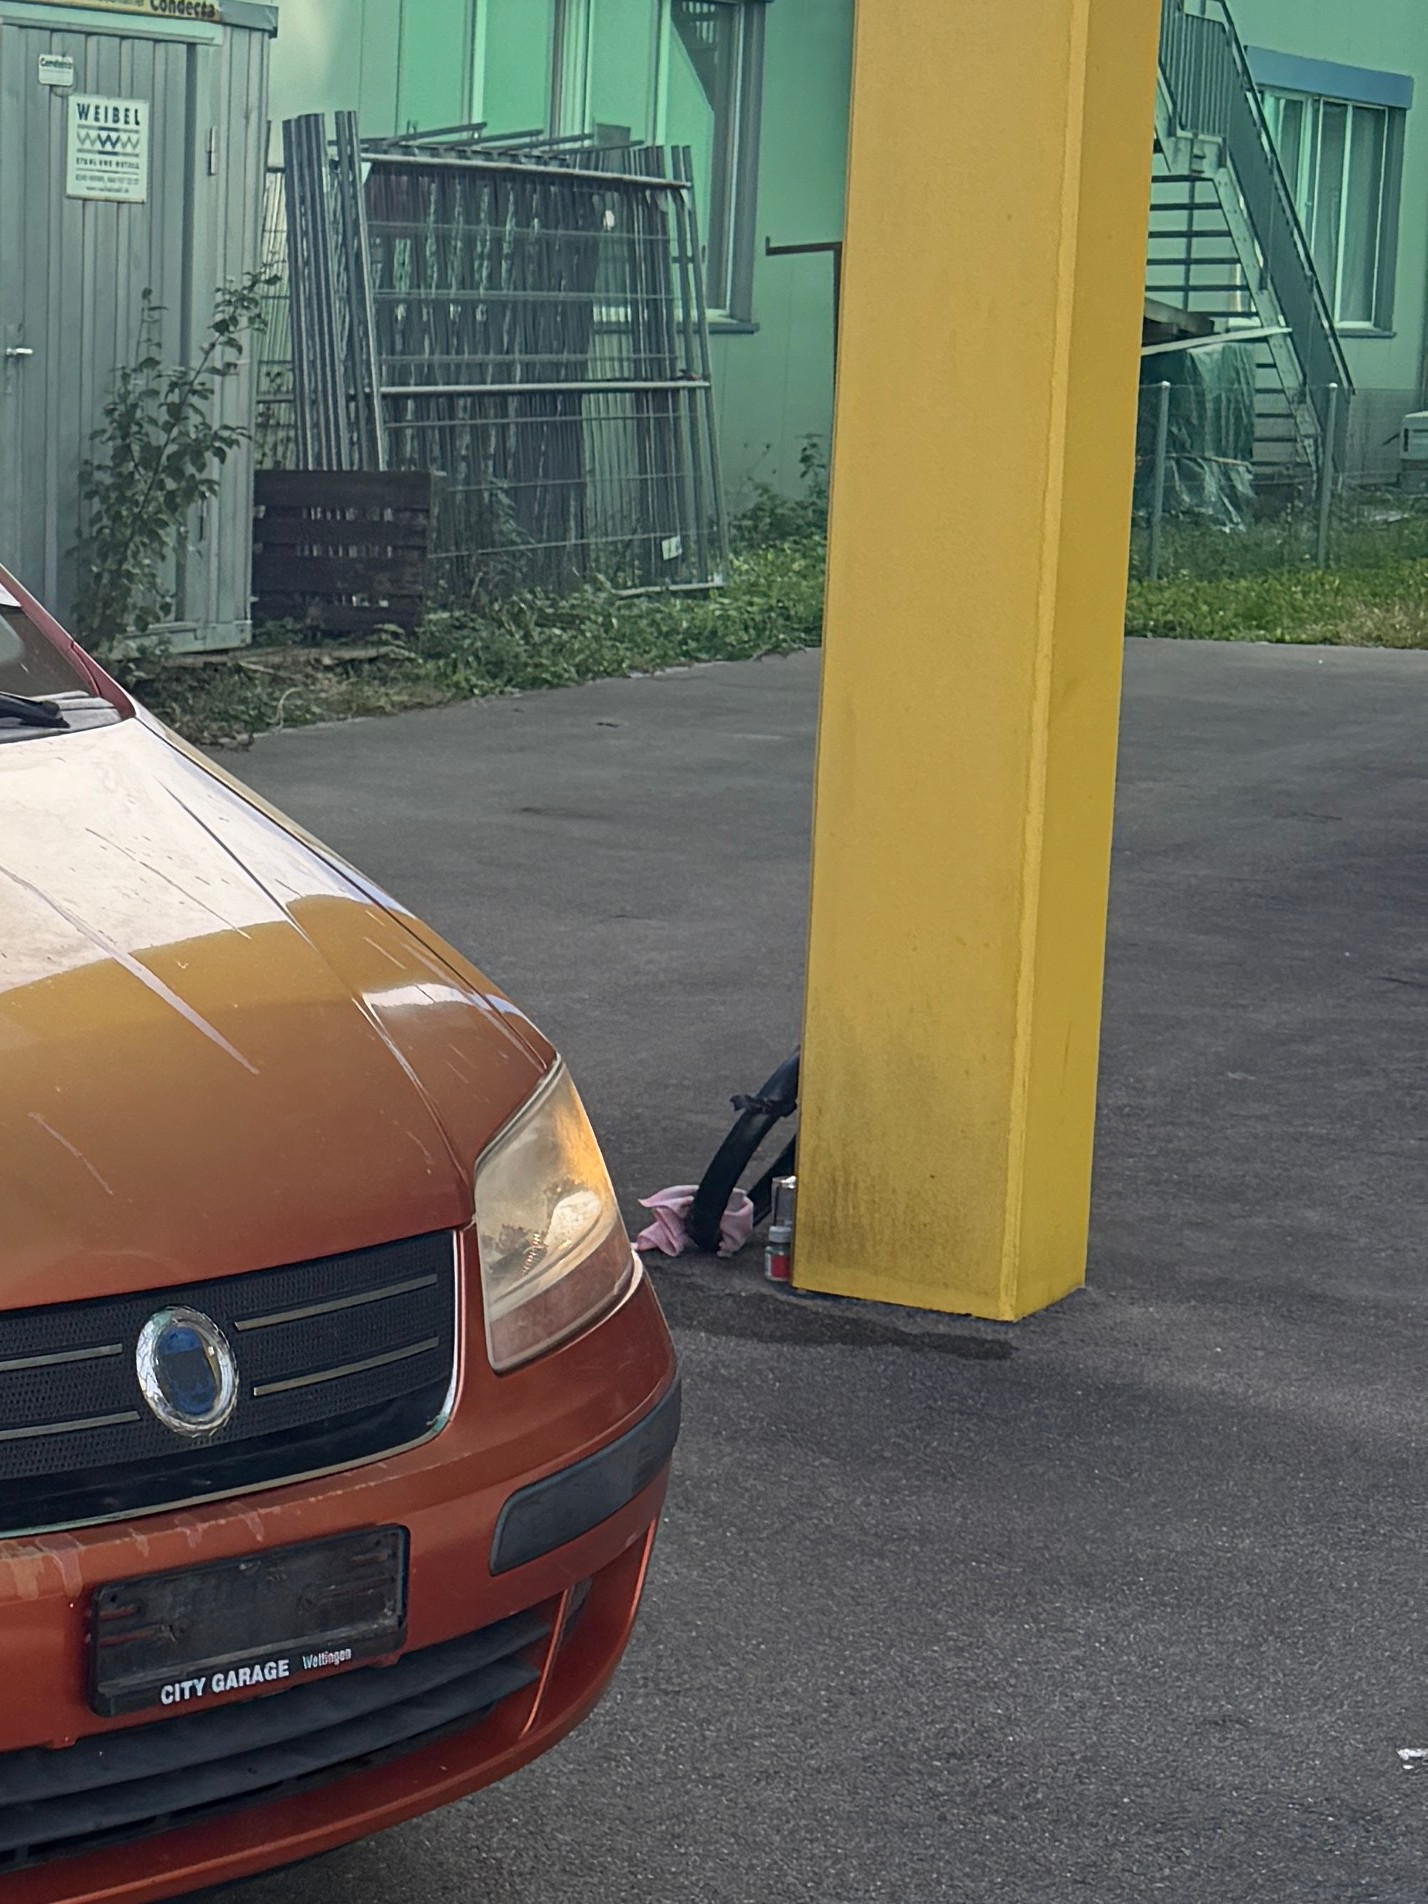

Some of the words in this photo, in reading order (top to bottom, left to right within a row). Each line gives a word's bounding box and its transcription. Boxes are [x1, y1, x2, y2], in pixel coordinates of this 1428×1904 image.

[76, 102, 141, 126] WEIBEL
[161, 1677, 206, 1705] CITY
[211, 1659, 290, 1693] GARAGE
